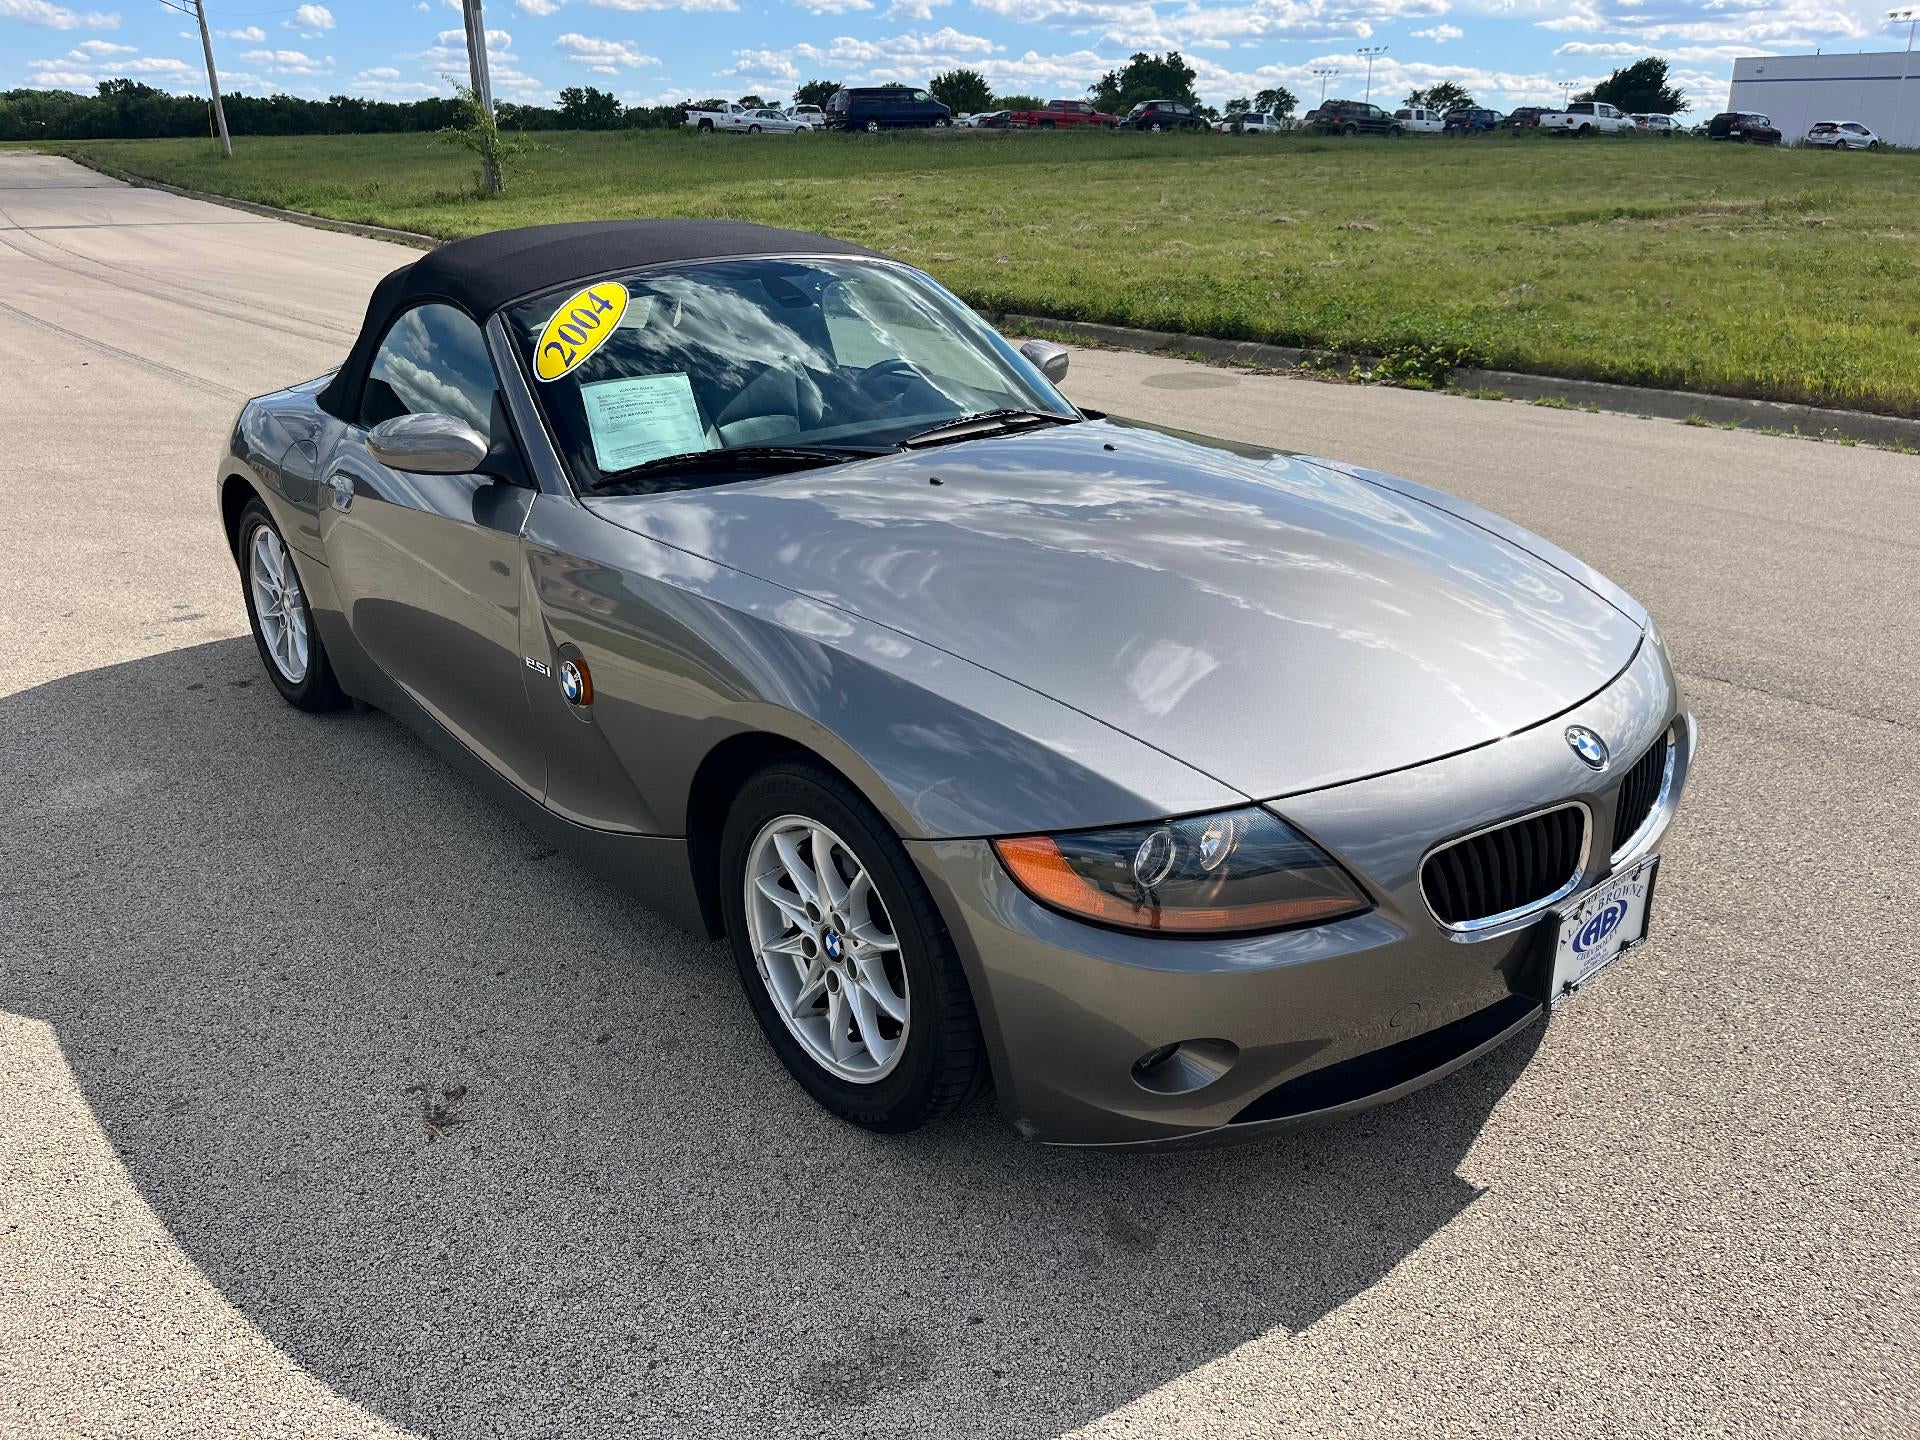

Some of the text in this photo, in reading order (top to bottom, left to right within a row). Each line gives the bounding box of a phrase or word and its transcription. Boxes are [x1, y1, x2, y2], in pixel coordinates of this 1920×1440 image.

[544, 291, 614, 368] 2004
[1598, 883, 1644, 911] BROWNE
[1582, 906, 1619, 946] AB
